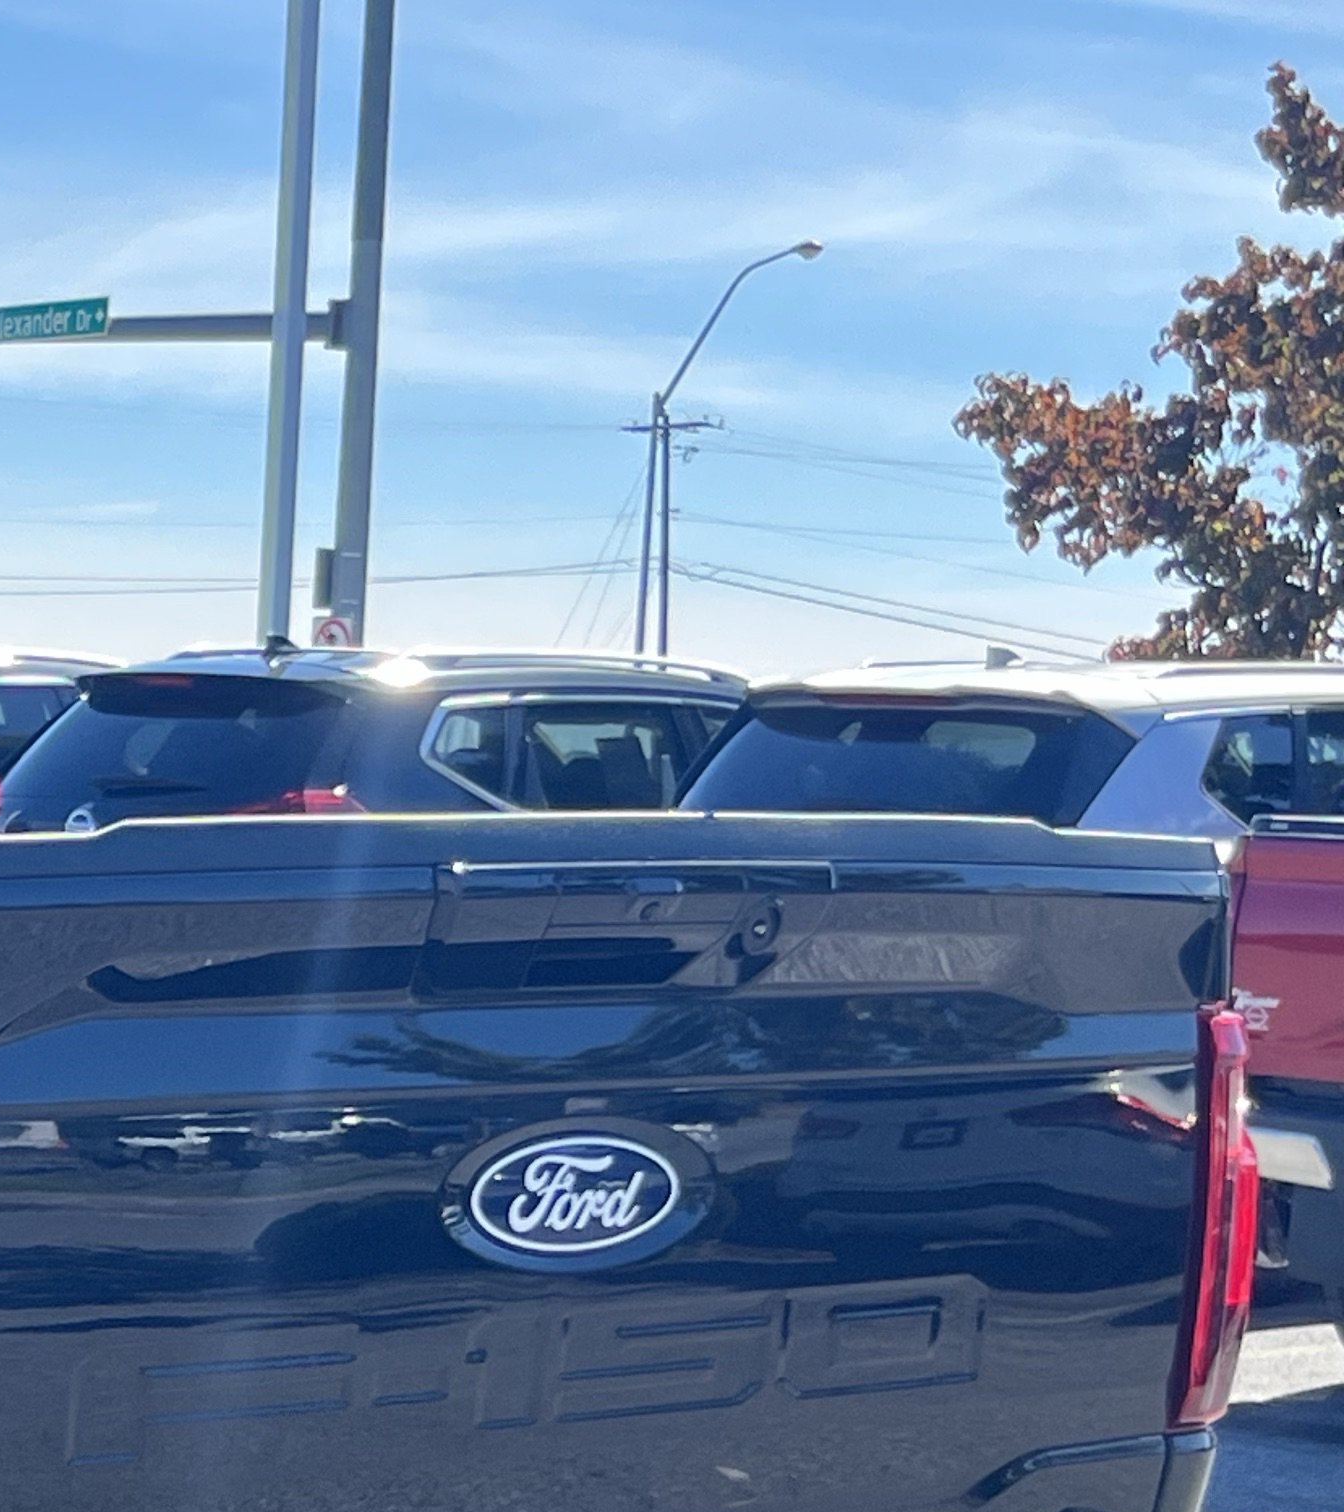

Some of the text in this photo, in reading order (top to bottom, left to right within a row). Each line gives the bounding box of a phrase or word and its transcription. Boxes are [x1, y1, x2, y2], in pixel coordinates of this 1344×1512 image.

[76, 309, 92, 331] Dr
[508, 1154, 645, 1232] Ford
[67, 1272, 989, 1467] F-150
